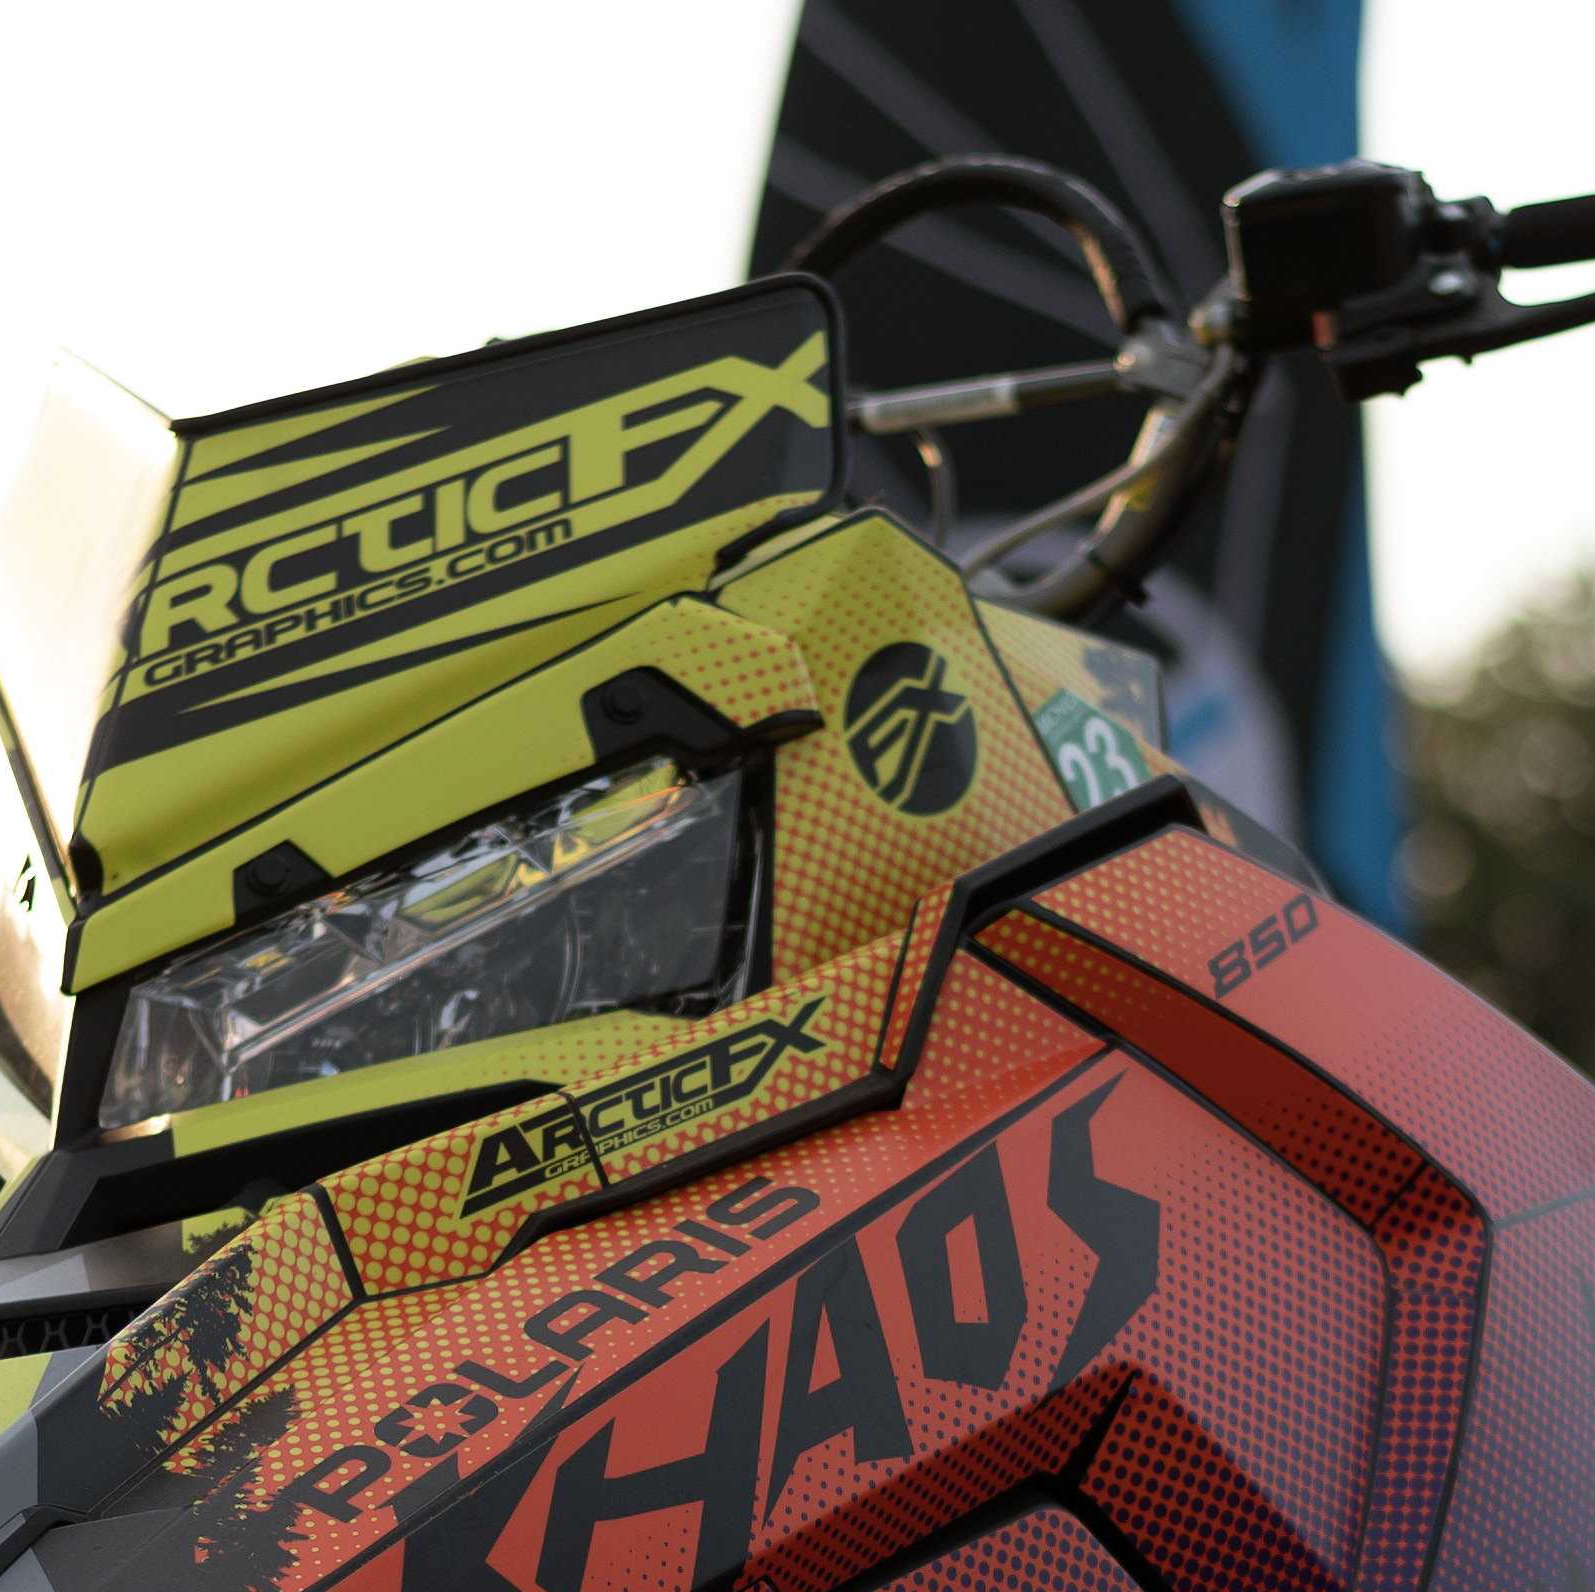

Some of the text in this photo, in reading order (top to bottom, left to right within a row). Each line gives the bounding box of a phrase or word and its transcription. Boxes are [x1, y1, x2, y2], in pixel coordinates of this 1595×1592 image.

[129, 330, 831, 658] RCTICFX
[1208, 894, 1320, 1001] 850
[288, 1175, 822, 1524] POLARIS
